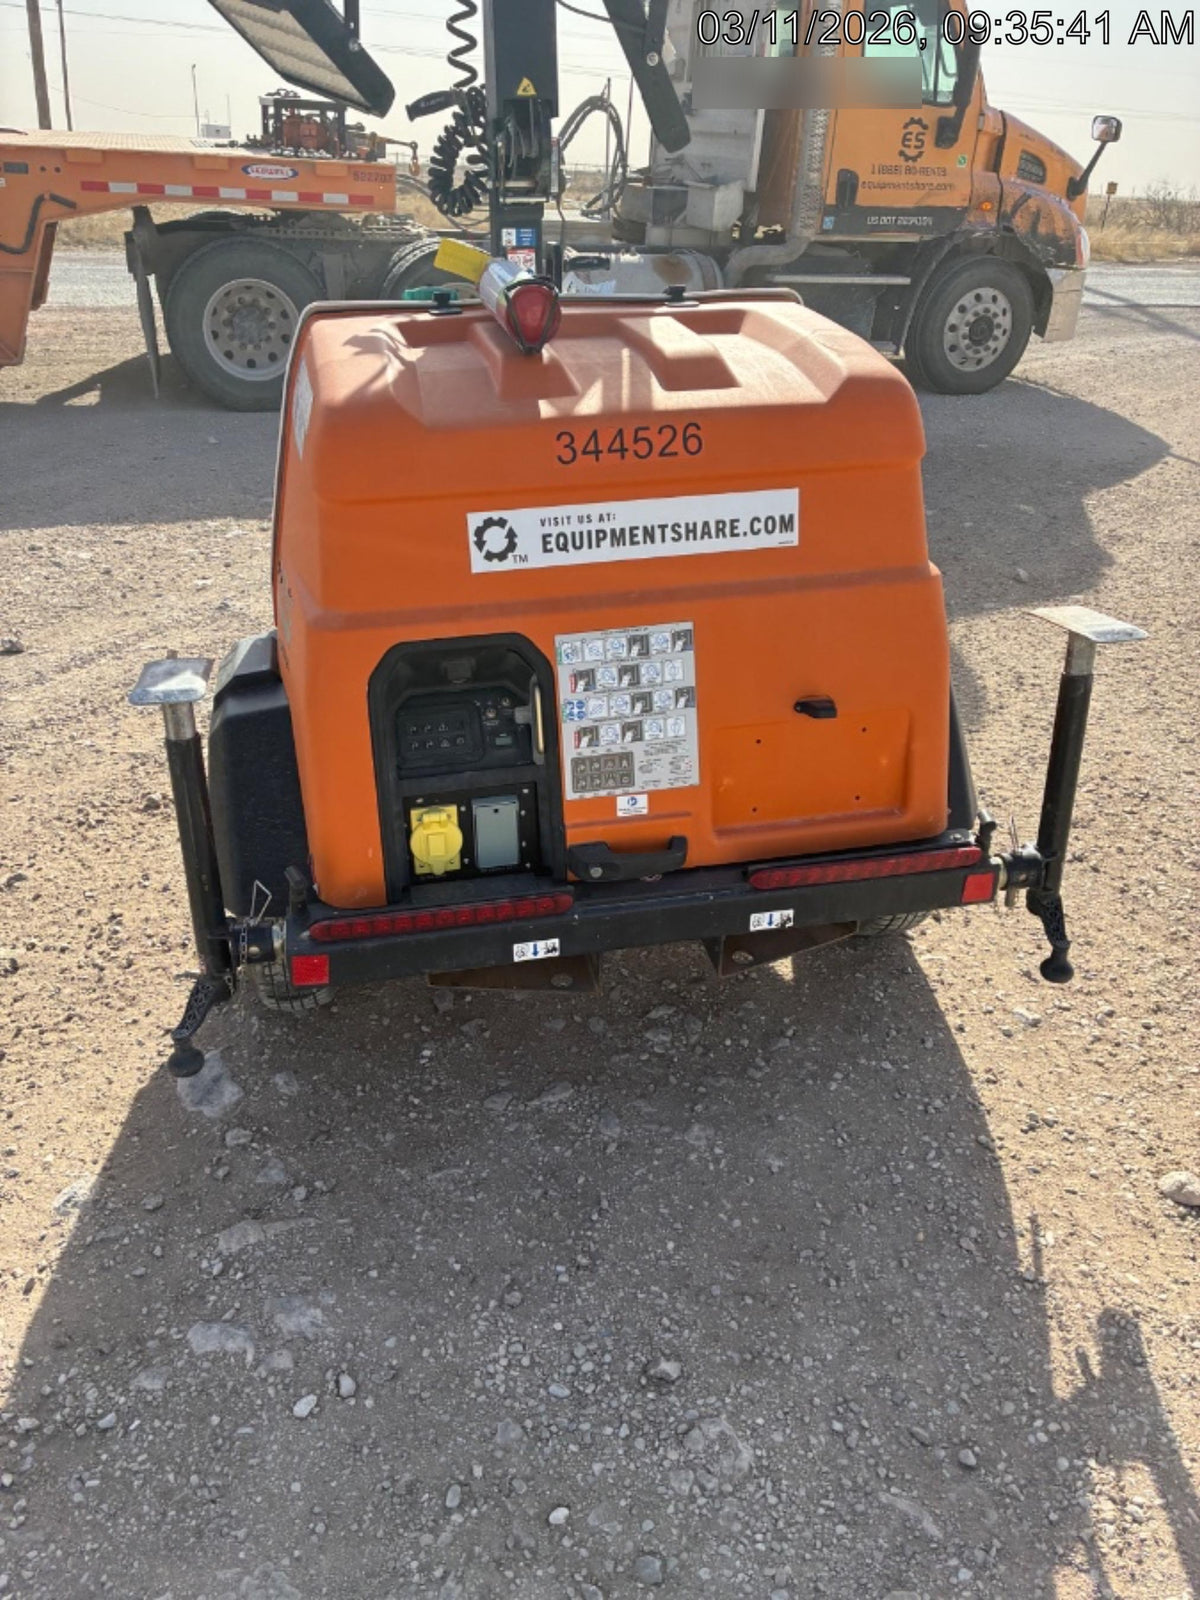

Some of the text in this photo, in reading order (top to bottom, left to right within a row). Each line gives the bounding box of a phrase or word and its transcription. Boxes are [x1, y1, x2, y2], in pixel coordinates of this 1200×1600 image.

[902, 131, 926, 149] ES
[556, 422, 704, 466] 344526
[540, 512, 617, 527] VISIT US AT:
[541, 513, 795, 554] EQUIPMENTSHARE.COM
[512, 554, 529, 564] TM
